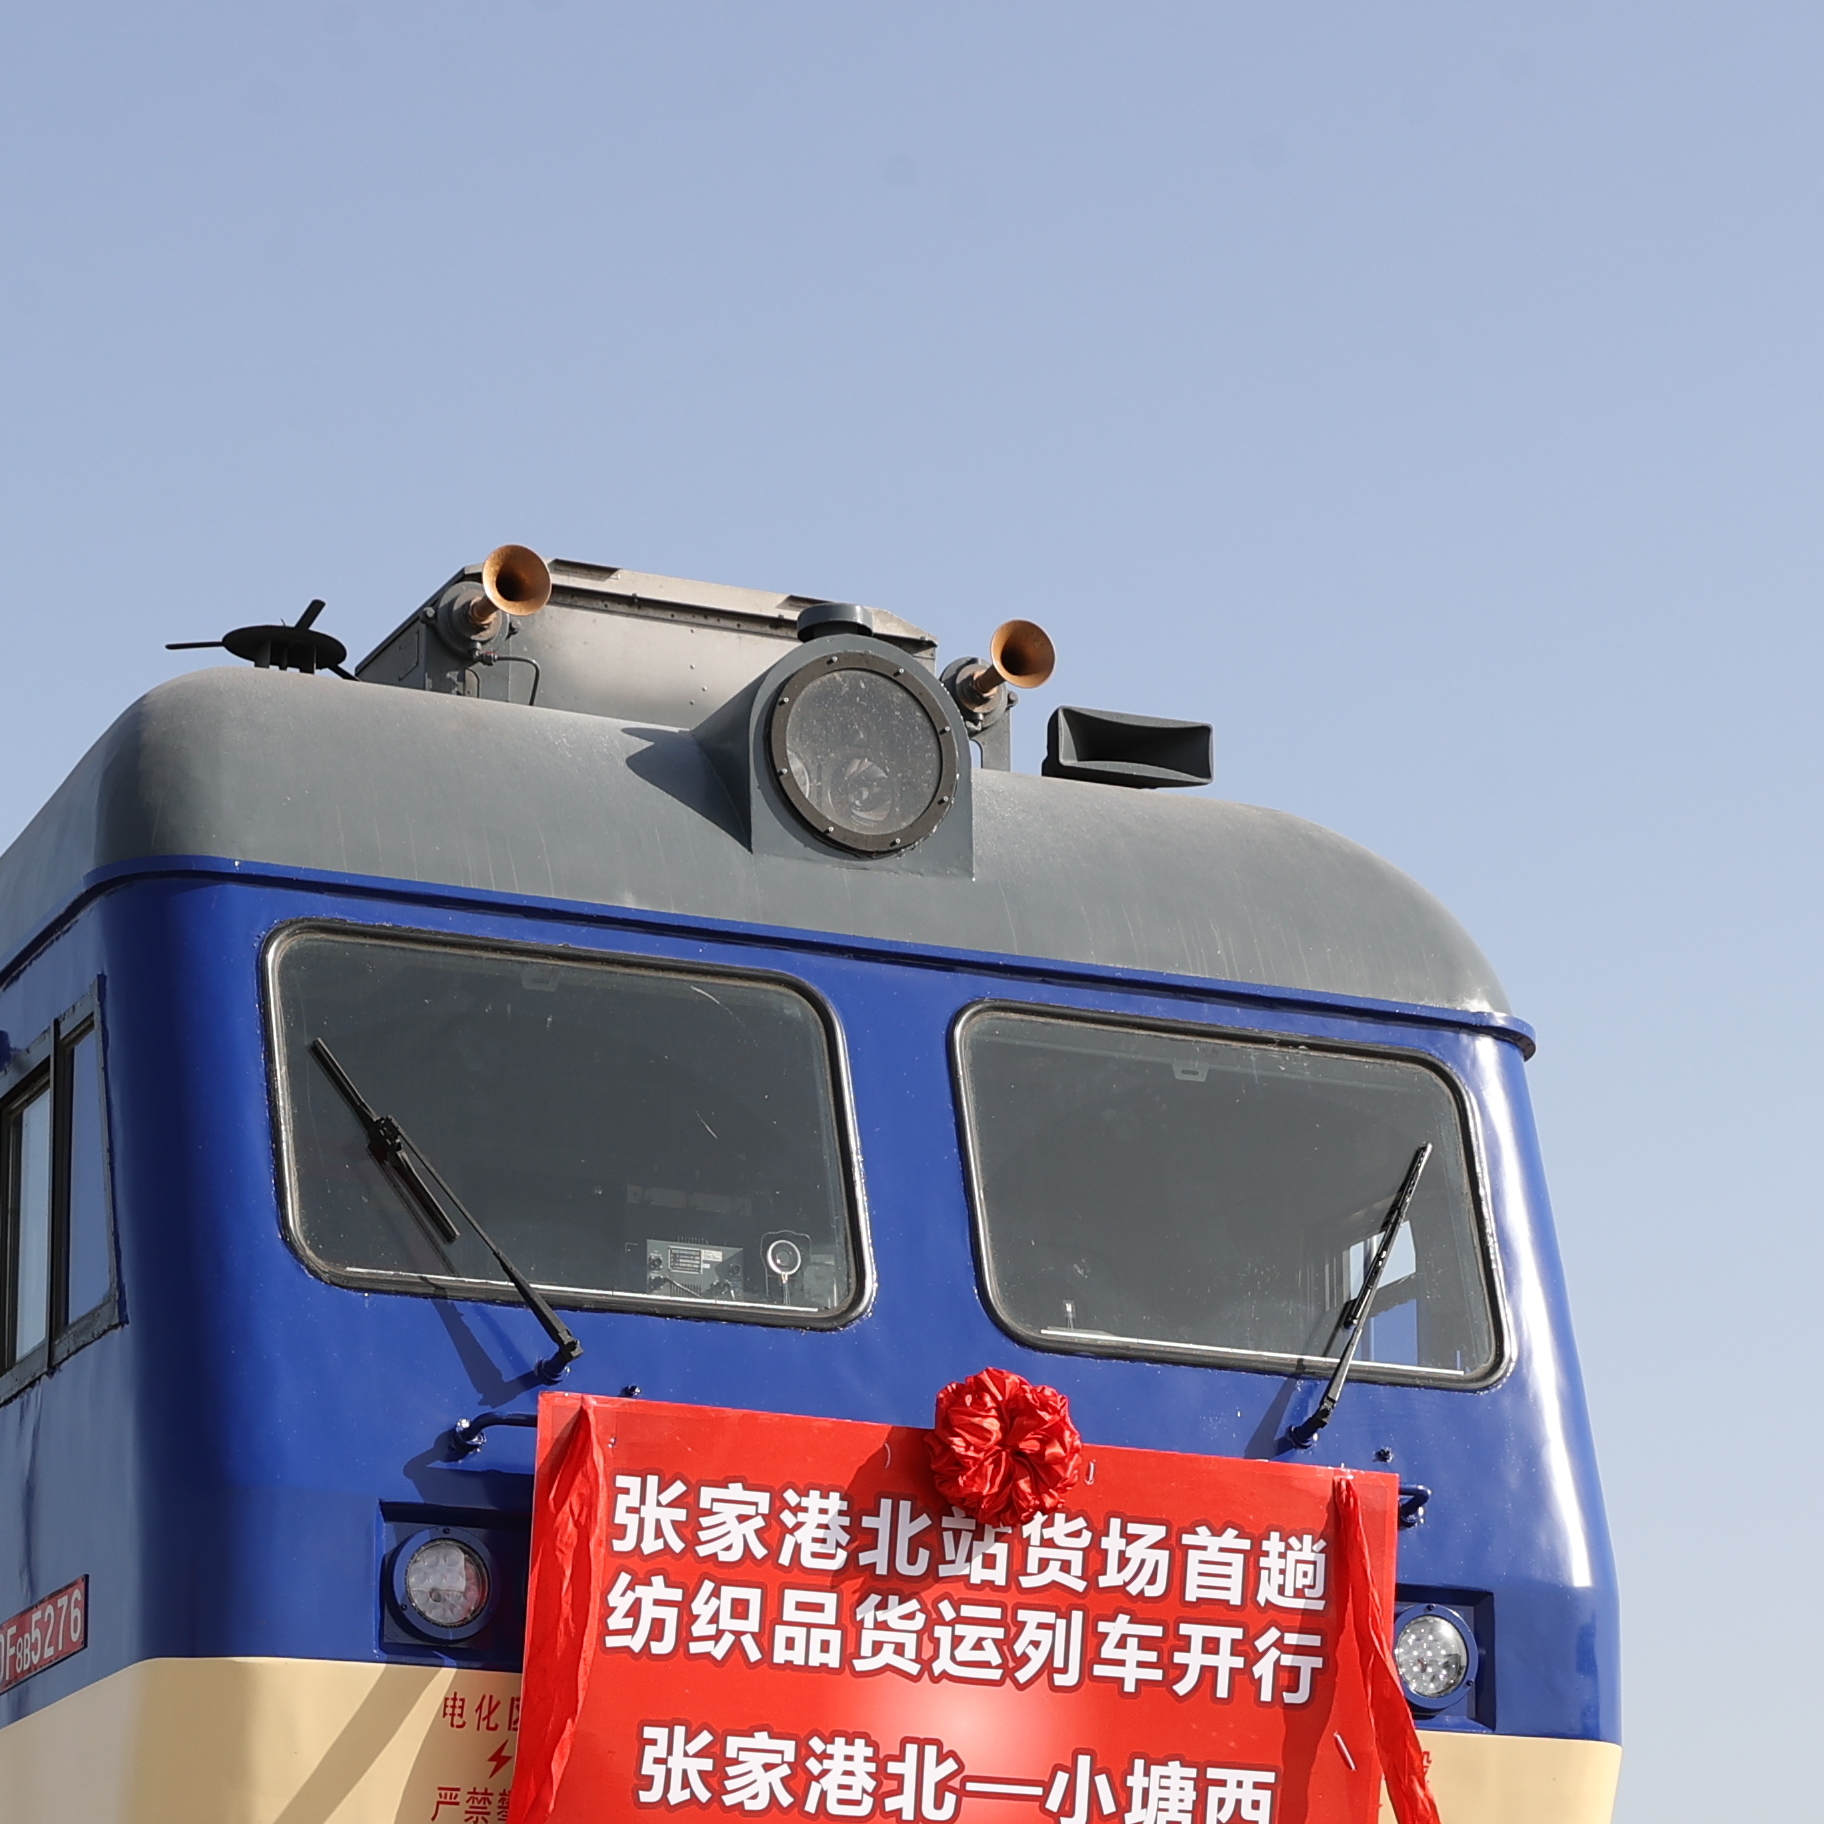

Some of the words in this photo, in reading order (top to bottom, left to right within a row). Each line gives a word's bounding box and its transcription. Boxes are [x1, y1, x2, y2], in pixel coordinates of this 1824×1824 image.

[611, 1474, 1327, 1613] 张家港北站货场首趟
[604, 1574, 1326, 1706] 纺织品货运列车开行
